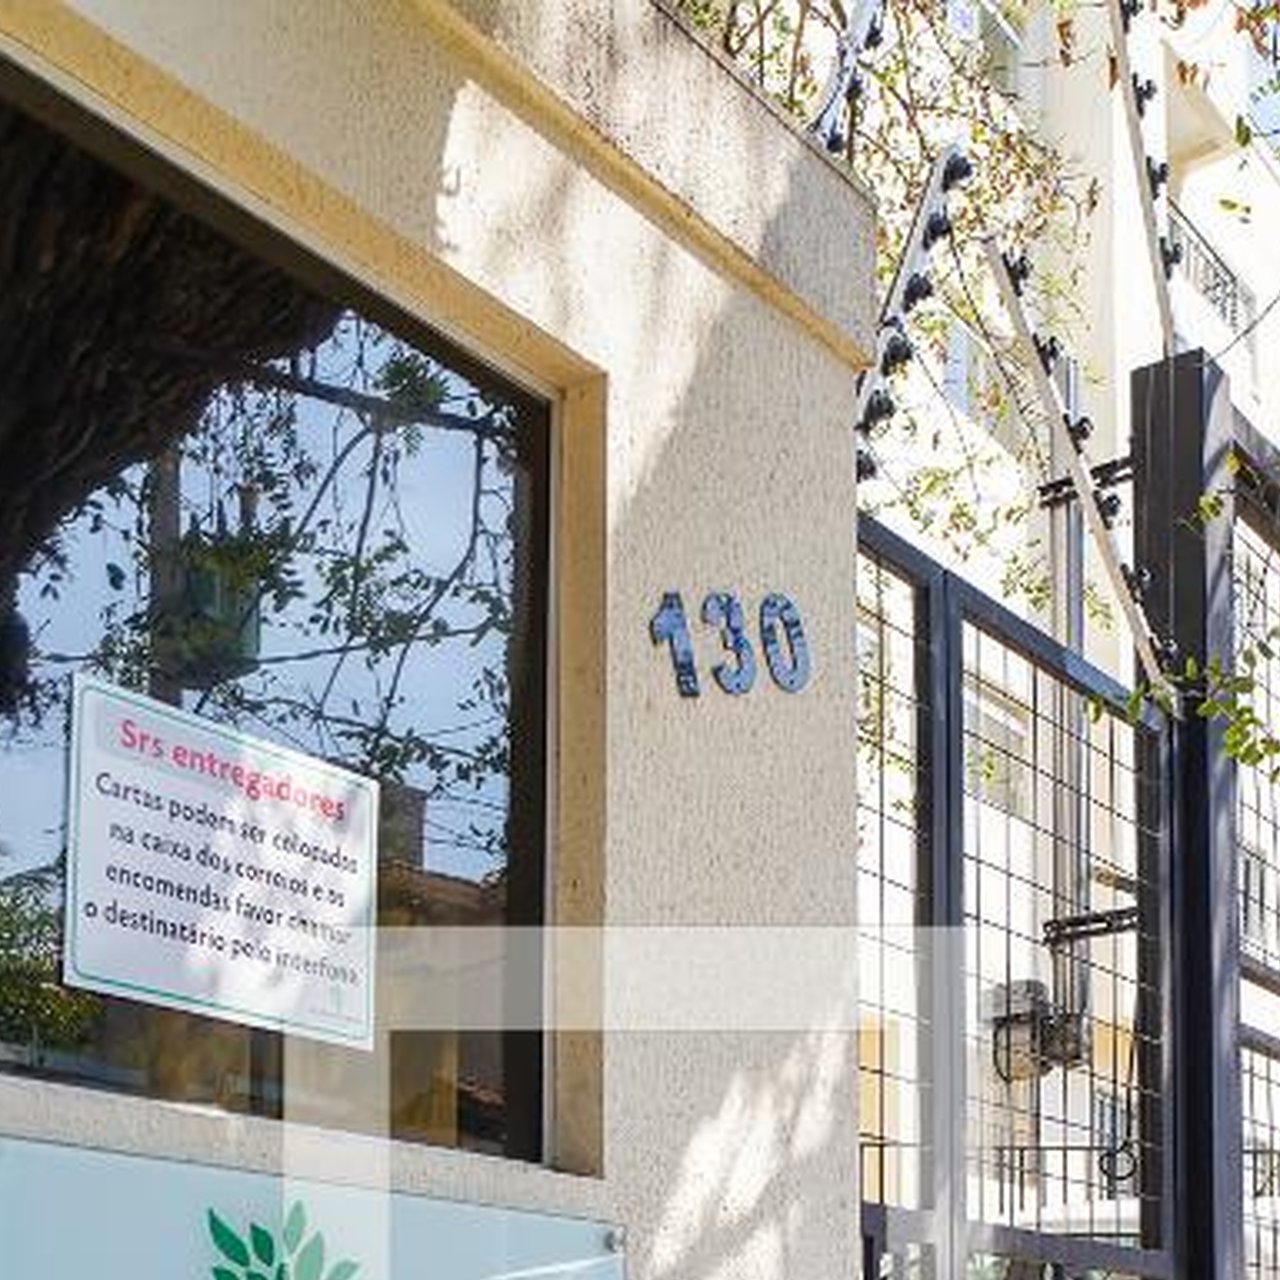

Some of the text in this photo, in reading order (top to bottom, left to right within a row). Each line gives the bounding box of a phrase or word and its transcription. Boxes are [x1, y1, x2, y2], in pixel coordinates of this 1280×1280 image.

[650, 593, 811, 697] 130
[121, 720, 346, 823] Srs entregadores
[96, 772, 163, 811] Cartas
[169, 799, 237, 834] podem
[109, 823, 135, 845] na
[141, 832, 192, 861] caixa
[196, 844, 232, 875] dos
[84, 901, 98, 918] o
[104, 900, 226, 952] destinatário
[106, 864, 230, 912] encomendas
[235, 893, 284, 926] favor
